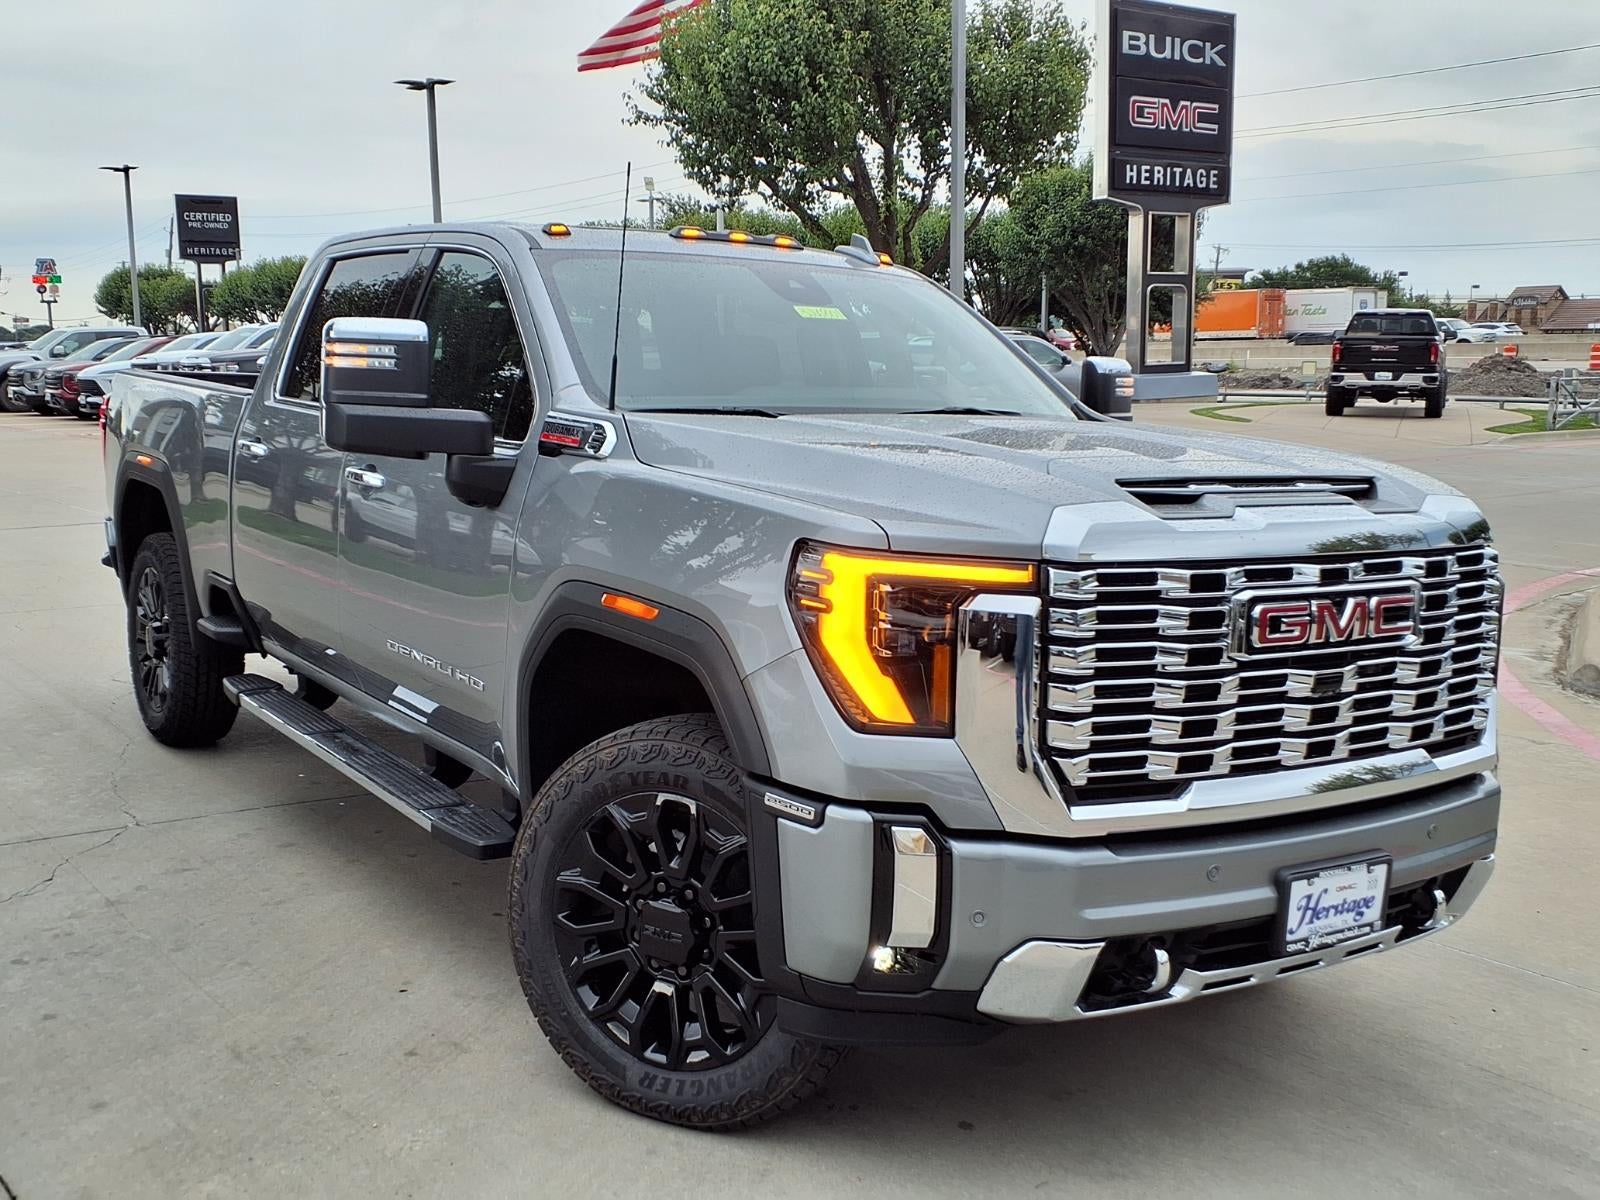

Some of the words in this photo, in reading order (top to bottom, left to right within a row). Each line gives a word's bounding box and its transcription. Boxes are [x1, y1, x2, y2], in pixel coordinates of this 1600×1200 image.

[1122, 30, 1227, 67] BUICK
[1129, 95, 1219, 135] GMC
[1125, 164, 1219, 189] HERITAGE
[183, 212, 232, 222] CERTIFIED
[187, 221, 229, 229] PRE-OWNED
[186, 247, 235, 256] HERITAGE
[1251, 594, 1416, 648] GMC
[386, 639, 454, 677] DENALI
[455, 668, 486, 692] HD
[1287, 887, 1376, 936] Heritage
